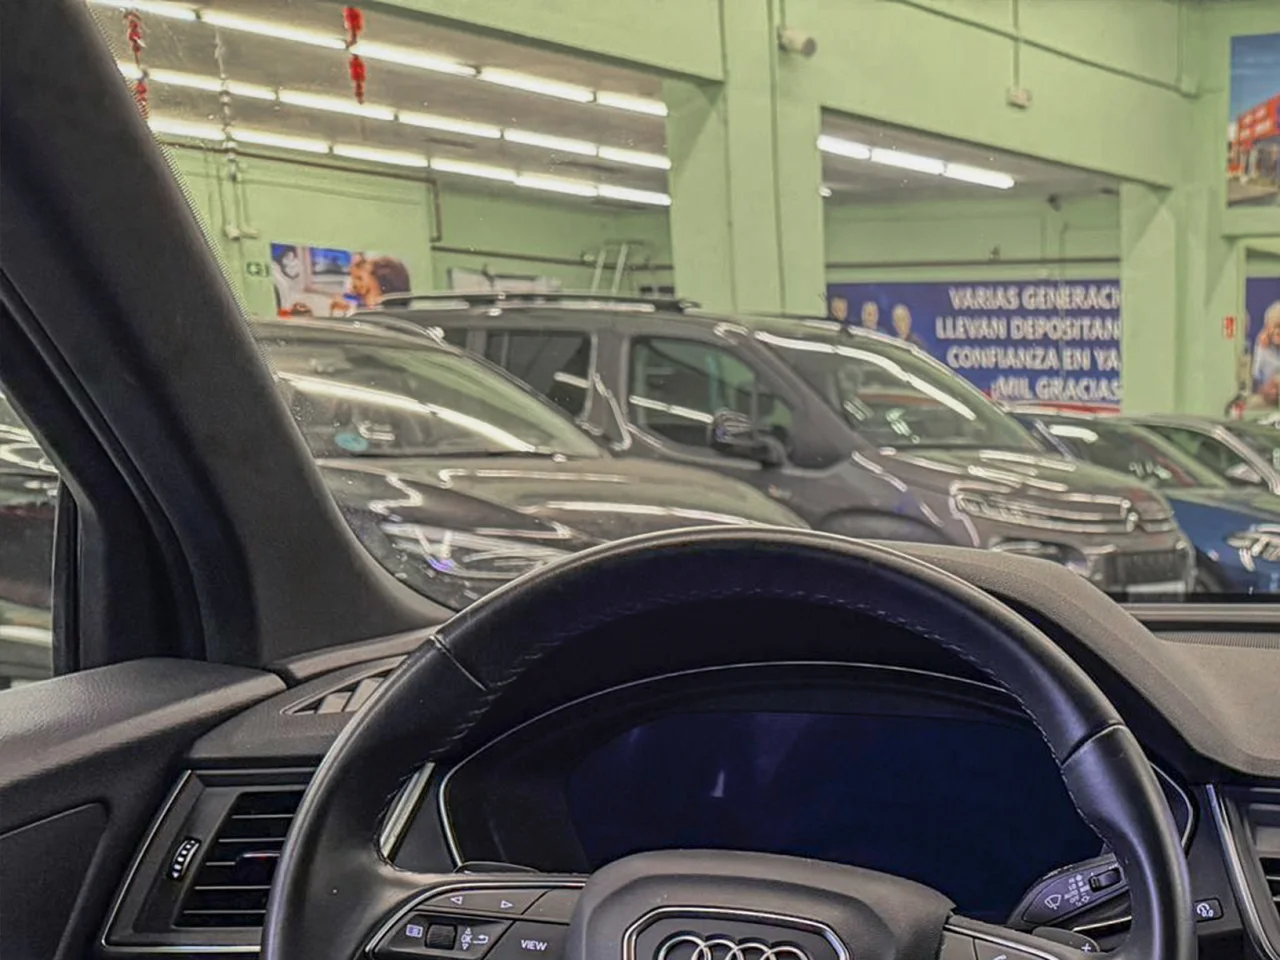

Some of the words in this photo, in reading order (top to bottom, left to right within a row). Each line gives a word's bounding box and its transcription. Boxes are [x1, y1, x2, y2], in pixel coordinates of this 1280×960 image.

[949, 286, 1019, 310] VARIAS
[935, 316, 1007, 340] LLEVAN
[947, 345, 1060, 370] CONFIANZA
[1062, 346, 1091, 370] EN
[521, 939, 548, 952] VIEW
